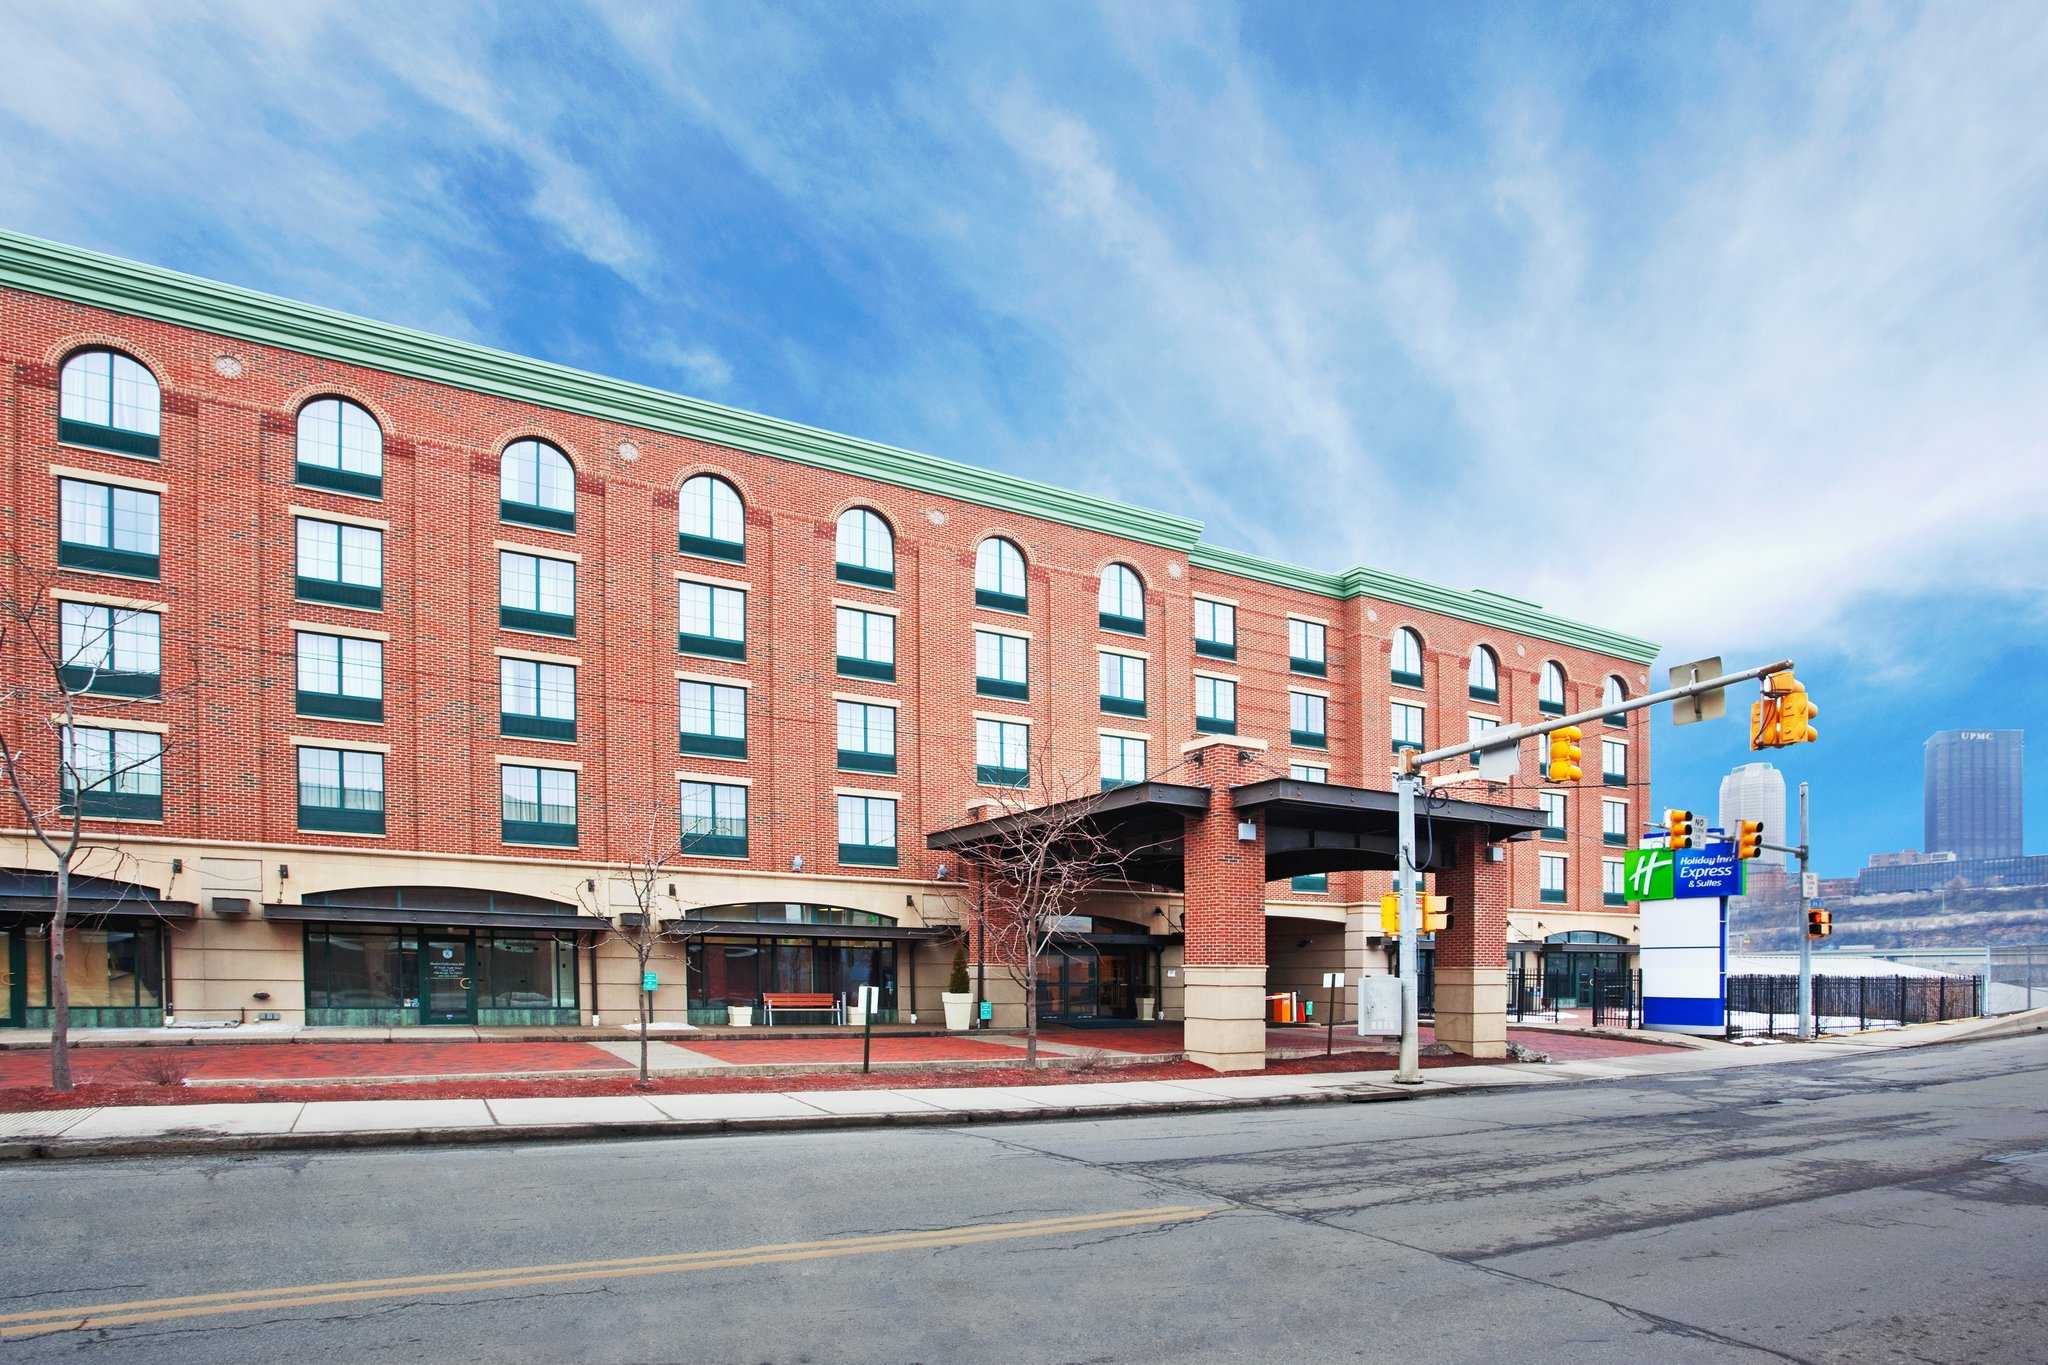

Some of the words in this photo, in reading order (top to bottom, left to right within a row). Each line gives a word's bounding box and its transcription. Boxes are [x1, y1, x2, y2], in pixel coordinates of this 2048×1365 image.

[1961, 732, 1993, 740] UPMC
[1695, 818, 1704, 827] NO
[1680, 855, 1715, 866] Holiday
[1716, 854, 1732, 864] Inn
[1680, 866, 1732, 880] Express
[1688, 880, 1695, 888] &
[1696, 879, 1722, 888] Suites
